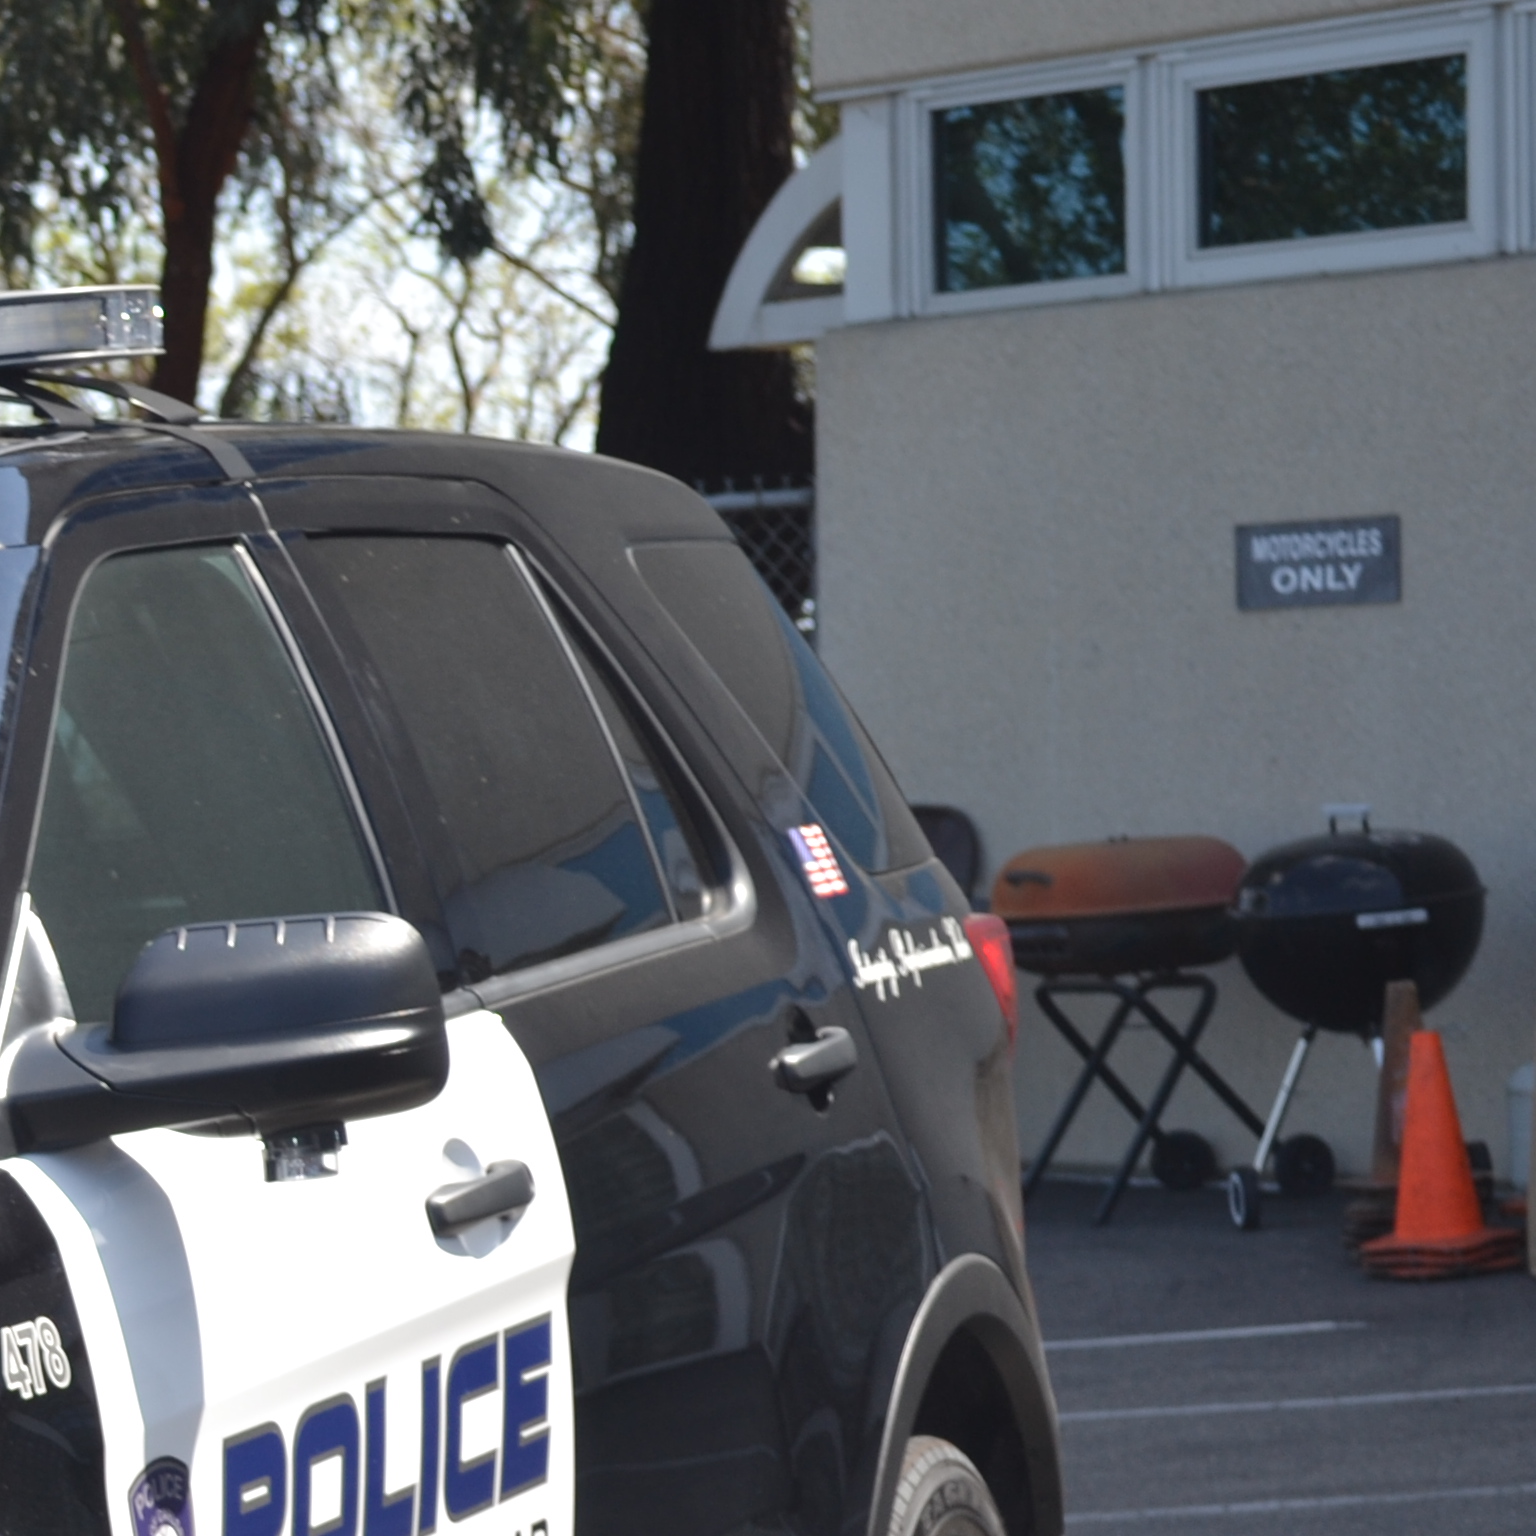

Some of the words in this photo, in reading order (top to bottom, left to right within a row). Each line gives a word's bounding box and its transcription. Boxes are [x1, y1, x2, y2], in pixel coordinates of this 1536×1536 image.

[1250, 527, 1383, 562] MOTORCYCLES
[1270, 562, 1363, 594] ONLY
[1, 1317, 71, 1398] 478
